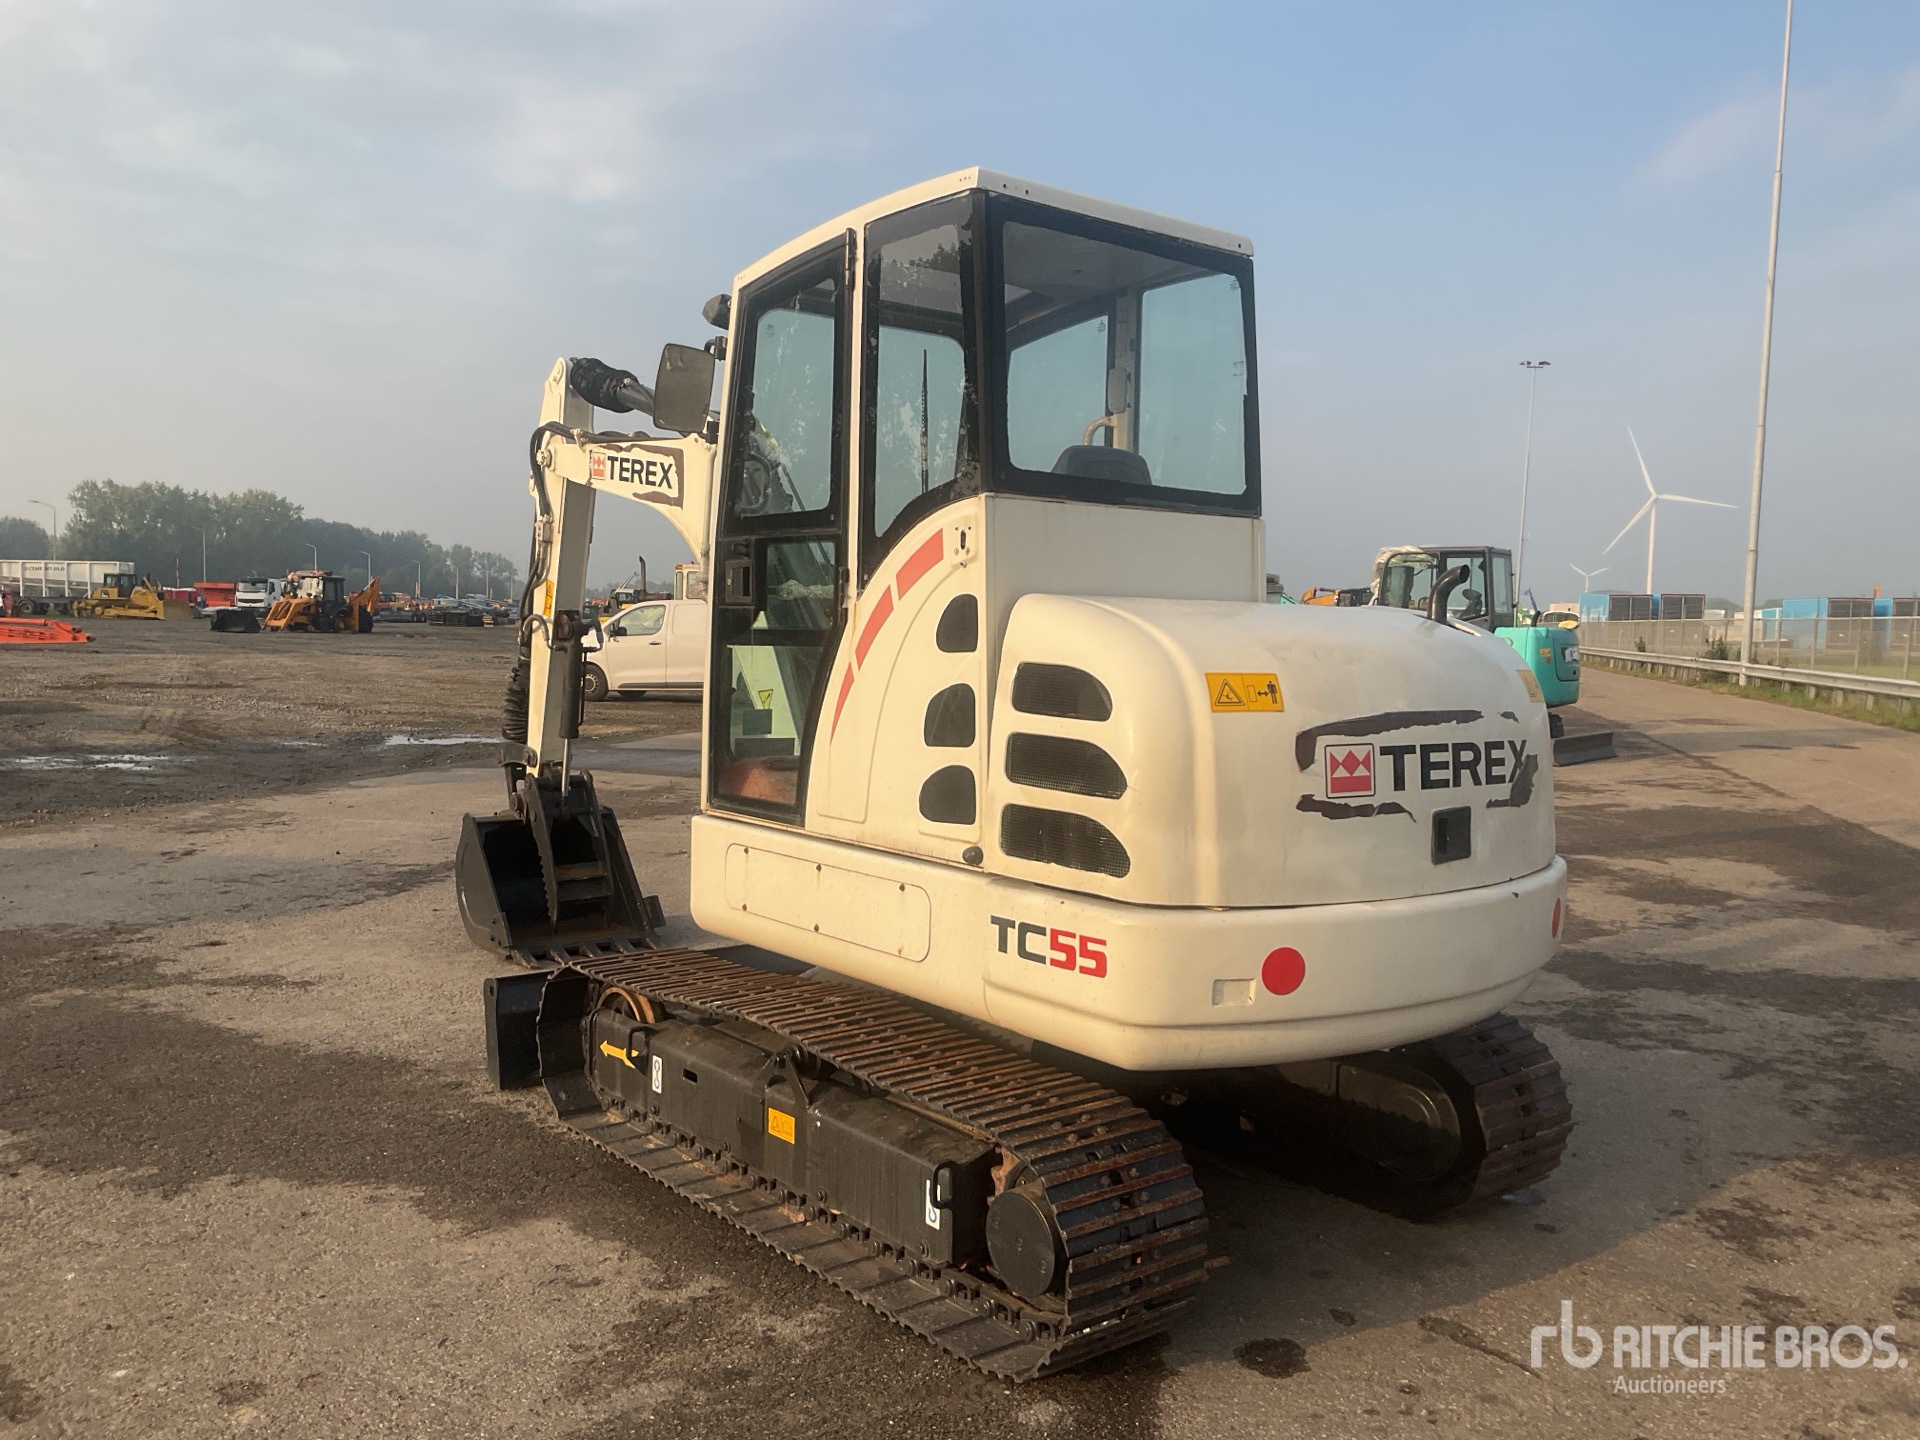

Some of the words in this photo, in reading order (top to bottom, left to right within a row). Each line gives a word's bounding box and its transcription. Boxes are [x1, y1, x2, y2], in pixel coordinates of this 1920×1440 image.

[607, 455, 674, 490] TEREX
[1379, 739, 1528, 792] TEREX
[990, 914, 1107, 979] TC55
